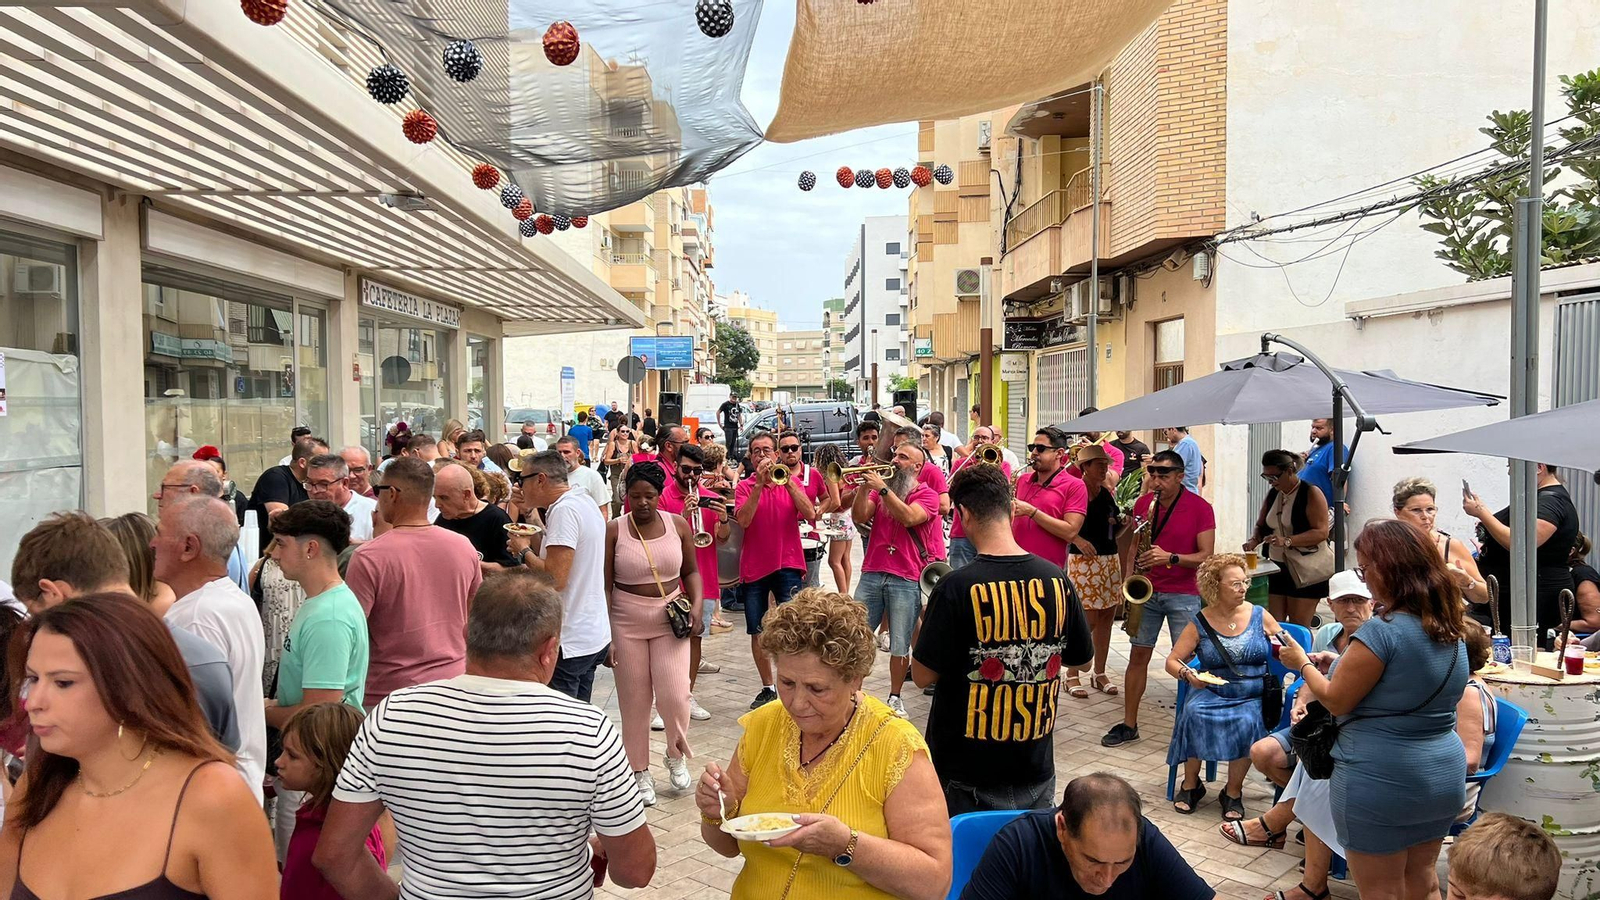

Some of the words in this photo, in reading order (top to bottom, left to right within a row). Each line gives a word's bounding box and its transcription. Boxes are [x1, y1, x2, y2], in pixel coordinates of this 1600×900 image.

[369, 285, 418, 316] CAFETERIA
[423, 302, 432, 319] LA
[436, 306, 458, 326] PLAZA
[970, 578, 1047, 643] GUNS
[964, 678, 1059, 742] ROSES
